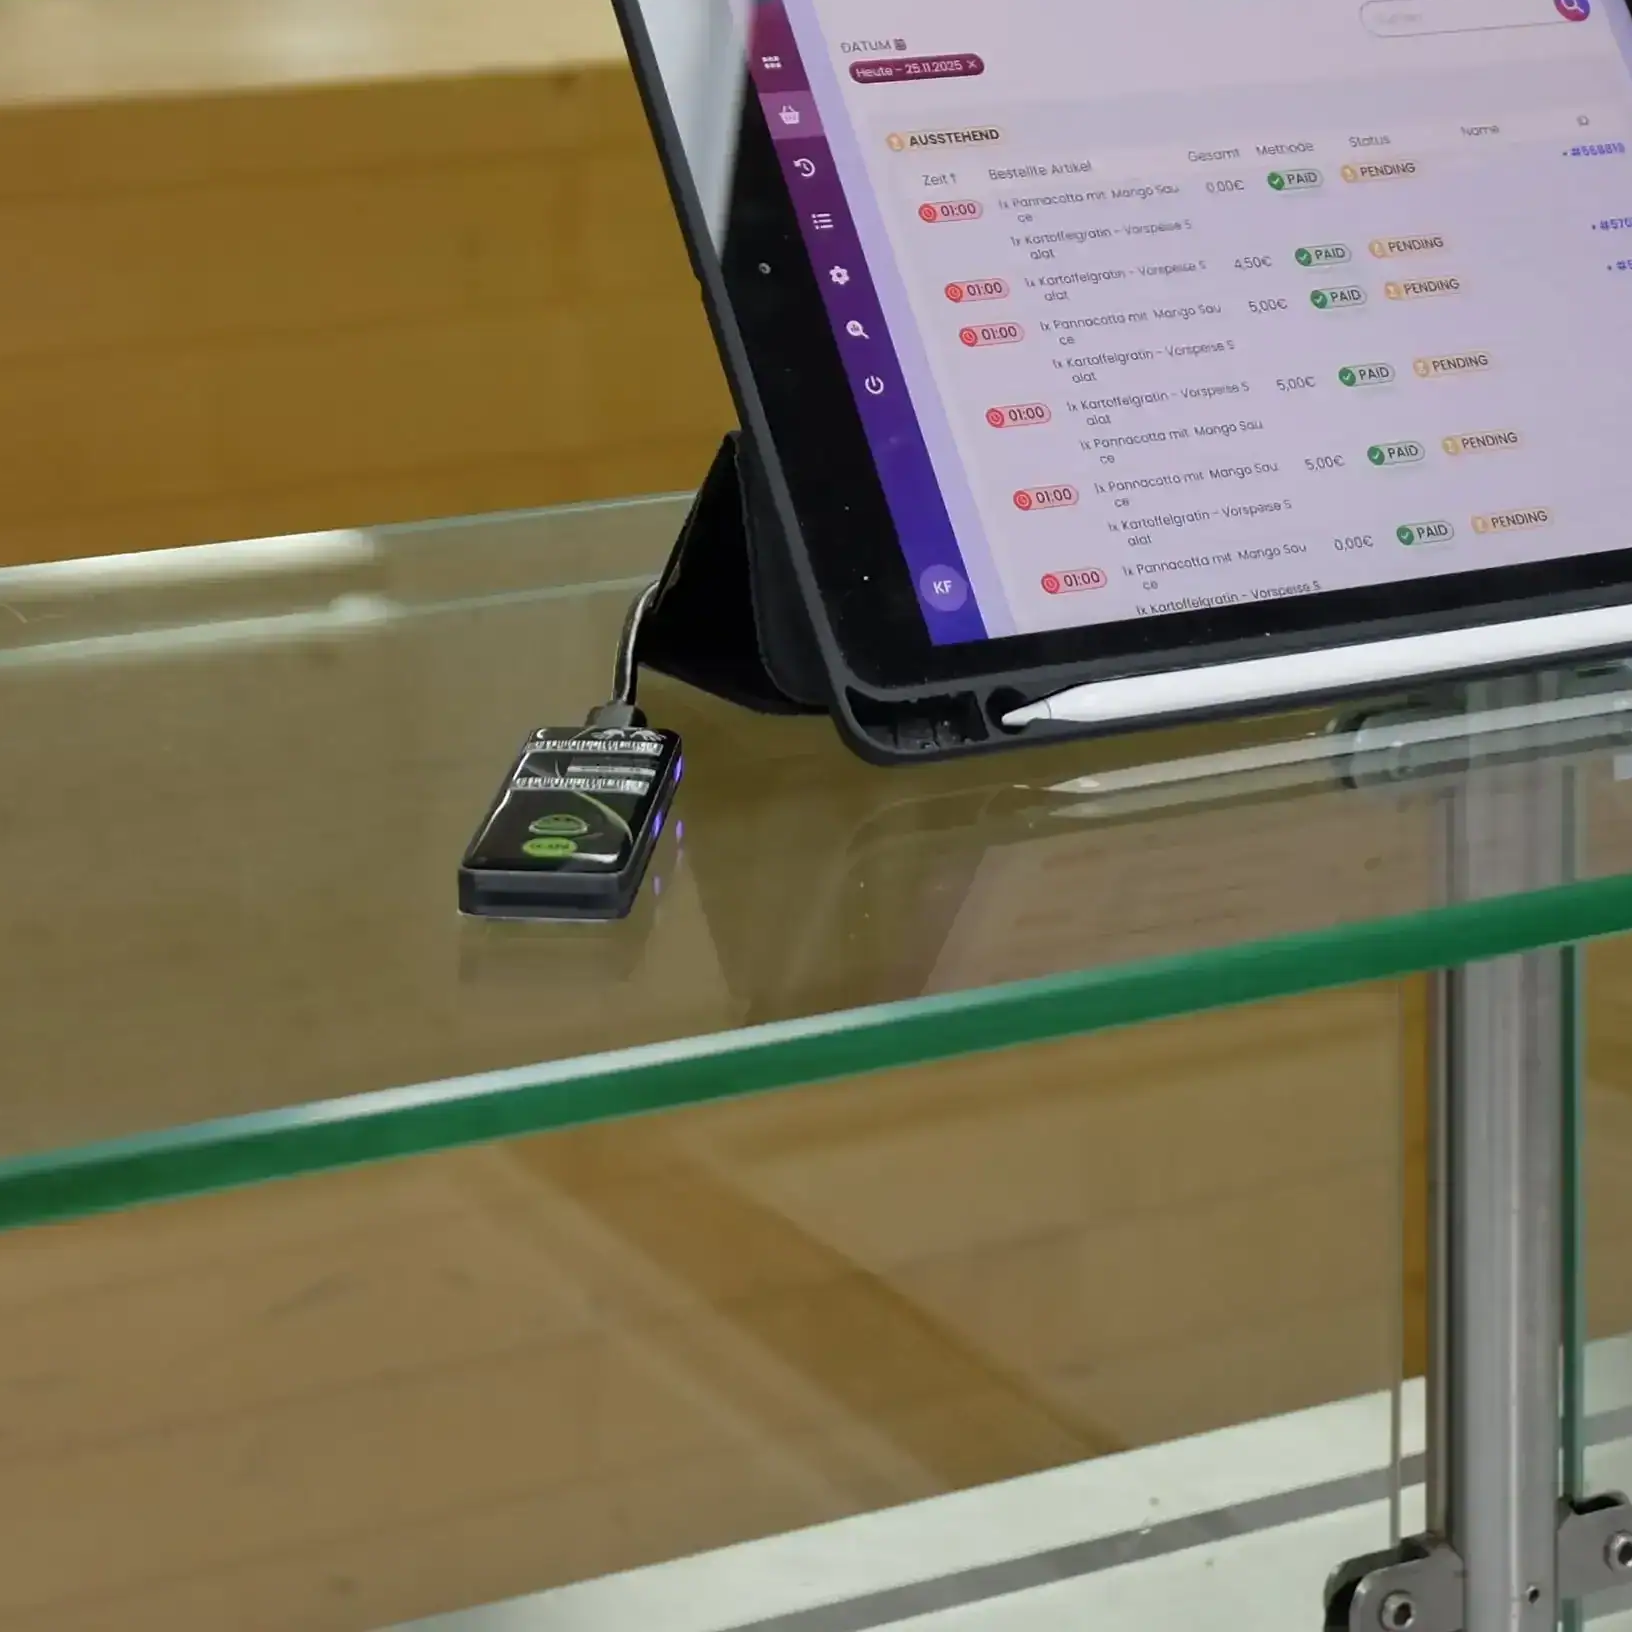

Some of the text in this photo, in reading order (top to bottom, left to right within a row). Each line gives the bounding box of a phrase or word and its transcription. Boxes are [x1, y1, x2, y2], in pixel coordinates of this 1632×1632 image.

[840, 39, 892, 54] DATUM
[855, 65, 893, 78] Heute
[904, 59, 963, 75] 25.11.2025
[909, 128, 1001, 148] AUSSTEHEND
[1348, 133, 1391, 148] Status
[1187, 148, 1240, 163] Gesamt
[1255, 141, 1314, 157] Methode
[988, 160, 1093, 181] Bestellte Artikel
[1287, 171, 1318, 185] PAID
[1359, 162, 1416, 178] PENDING
[922, 173, 948, 187] Zeit
[1205, 178, 1245, 194] 0,00€
[1011, 190, 1084, 209] Pannacotta
[1111, 184, 1154, 200] Mango
[940, 203, 977, 218] 01:00
[1017, 212, 1034, 225] ce
[1024, 227, 1112, 247] Kartoffelgratin
[1124, 221, 1183, 240] Vorspeise
[1387, 236, 1445, 253] PENDING
[1030, 247, 1056, 261] alat
[1314, 247, 1346, 261] PAID
[1038, 267, 1126, 288] Kartoffelgratin
[1137, 261, 1197, 279] Vorspeise
[966, 282, 1003, 297] 01:00
[1403, 277, 1460, 295] PENDING
[1044, 289, 1069, 302] alat
[1330, 288, 1362, 303] PAID
[1248, 298, 1288, 314] 5,00€
[1053, 312, 1126, 331] Pannacotta
[1153, 305, 1196, 321] Mango
[1198, 303, 1222, 316] Sau
[981, 325, 1018, 341] 01:00
[1058, 335, 1076, 347] ce
[1066, 348, 1154, 368] Kartoffelgratin
[1165, 340, 1225, 359] Vorspeise
[1431, 354, 1489, 372] PENDING
[1071, 370, 1097, 384] alat
[1358, 366, 1390, 381] PAID
[1276, 376, 1316, 393] 5,00€
[1080, 390, 1168, 412] Kartoffelgratin
[1180, 381, 1240, 400] Vorspeise
[1008, 405, 1045, 422] 01:00
[1086, 413, 1112, 426] alat
[1093, 430, 1166, 450] Pannacotta
[1169, 428, 1188, 441] mit
[1194, 422, 1238, 438] Mango
[1239, 419, 1264, 432] Sau
[1461, 431, 1518, 450] PENDING
[1100, 452, 1116, 465] ce
[1387, 444, 1419, 459] PAID
[1304, 454, 1345, 472] 5,00€
[1108, 473, 1181, 493] Pannacotta
[1184, 470, 1204, 483] mit
[1209, 464, 1253, 481] Mango
[1254, 462, 1278, 474] Sau
[1035, 487, 1073, 504] 01:00
[1114, 496, 1130, 509] ce
[1121, 510, 1210, 532] Kartoffelgratin
[1222, 500, 1282, 519] Vorspeise
[1491, 510, 1548, 529] PENDING
[1416, 523, 1448, 539] PAID
[1127, 534, 1152, 547] alat
[1334, 534, 1374, 553] 0,00€
[1136, 555, 1210, 576] Pannacotta
[1212, 552, 1232, 565] mit
[1237, 546, 1281, 563] Mango
[1283, 543, 1307, 556] Sau
[1063, 570, 1101, 587] 01:00
[1142, 579, 1158, 591] ce
[932, 579, 953, 595] KF
[1150, 592, 1239, 614] Kartoffelgratin
[1250, 581, 1311, 600] Vorspeise
